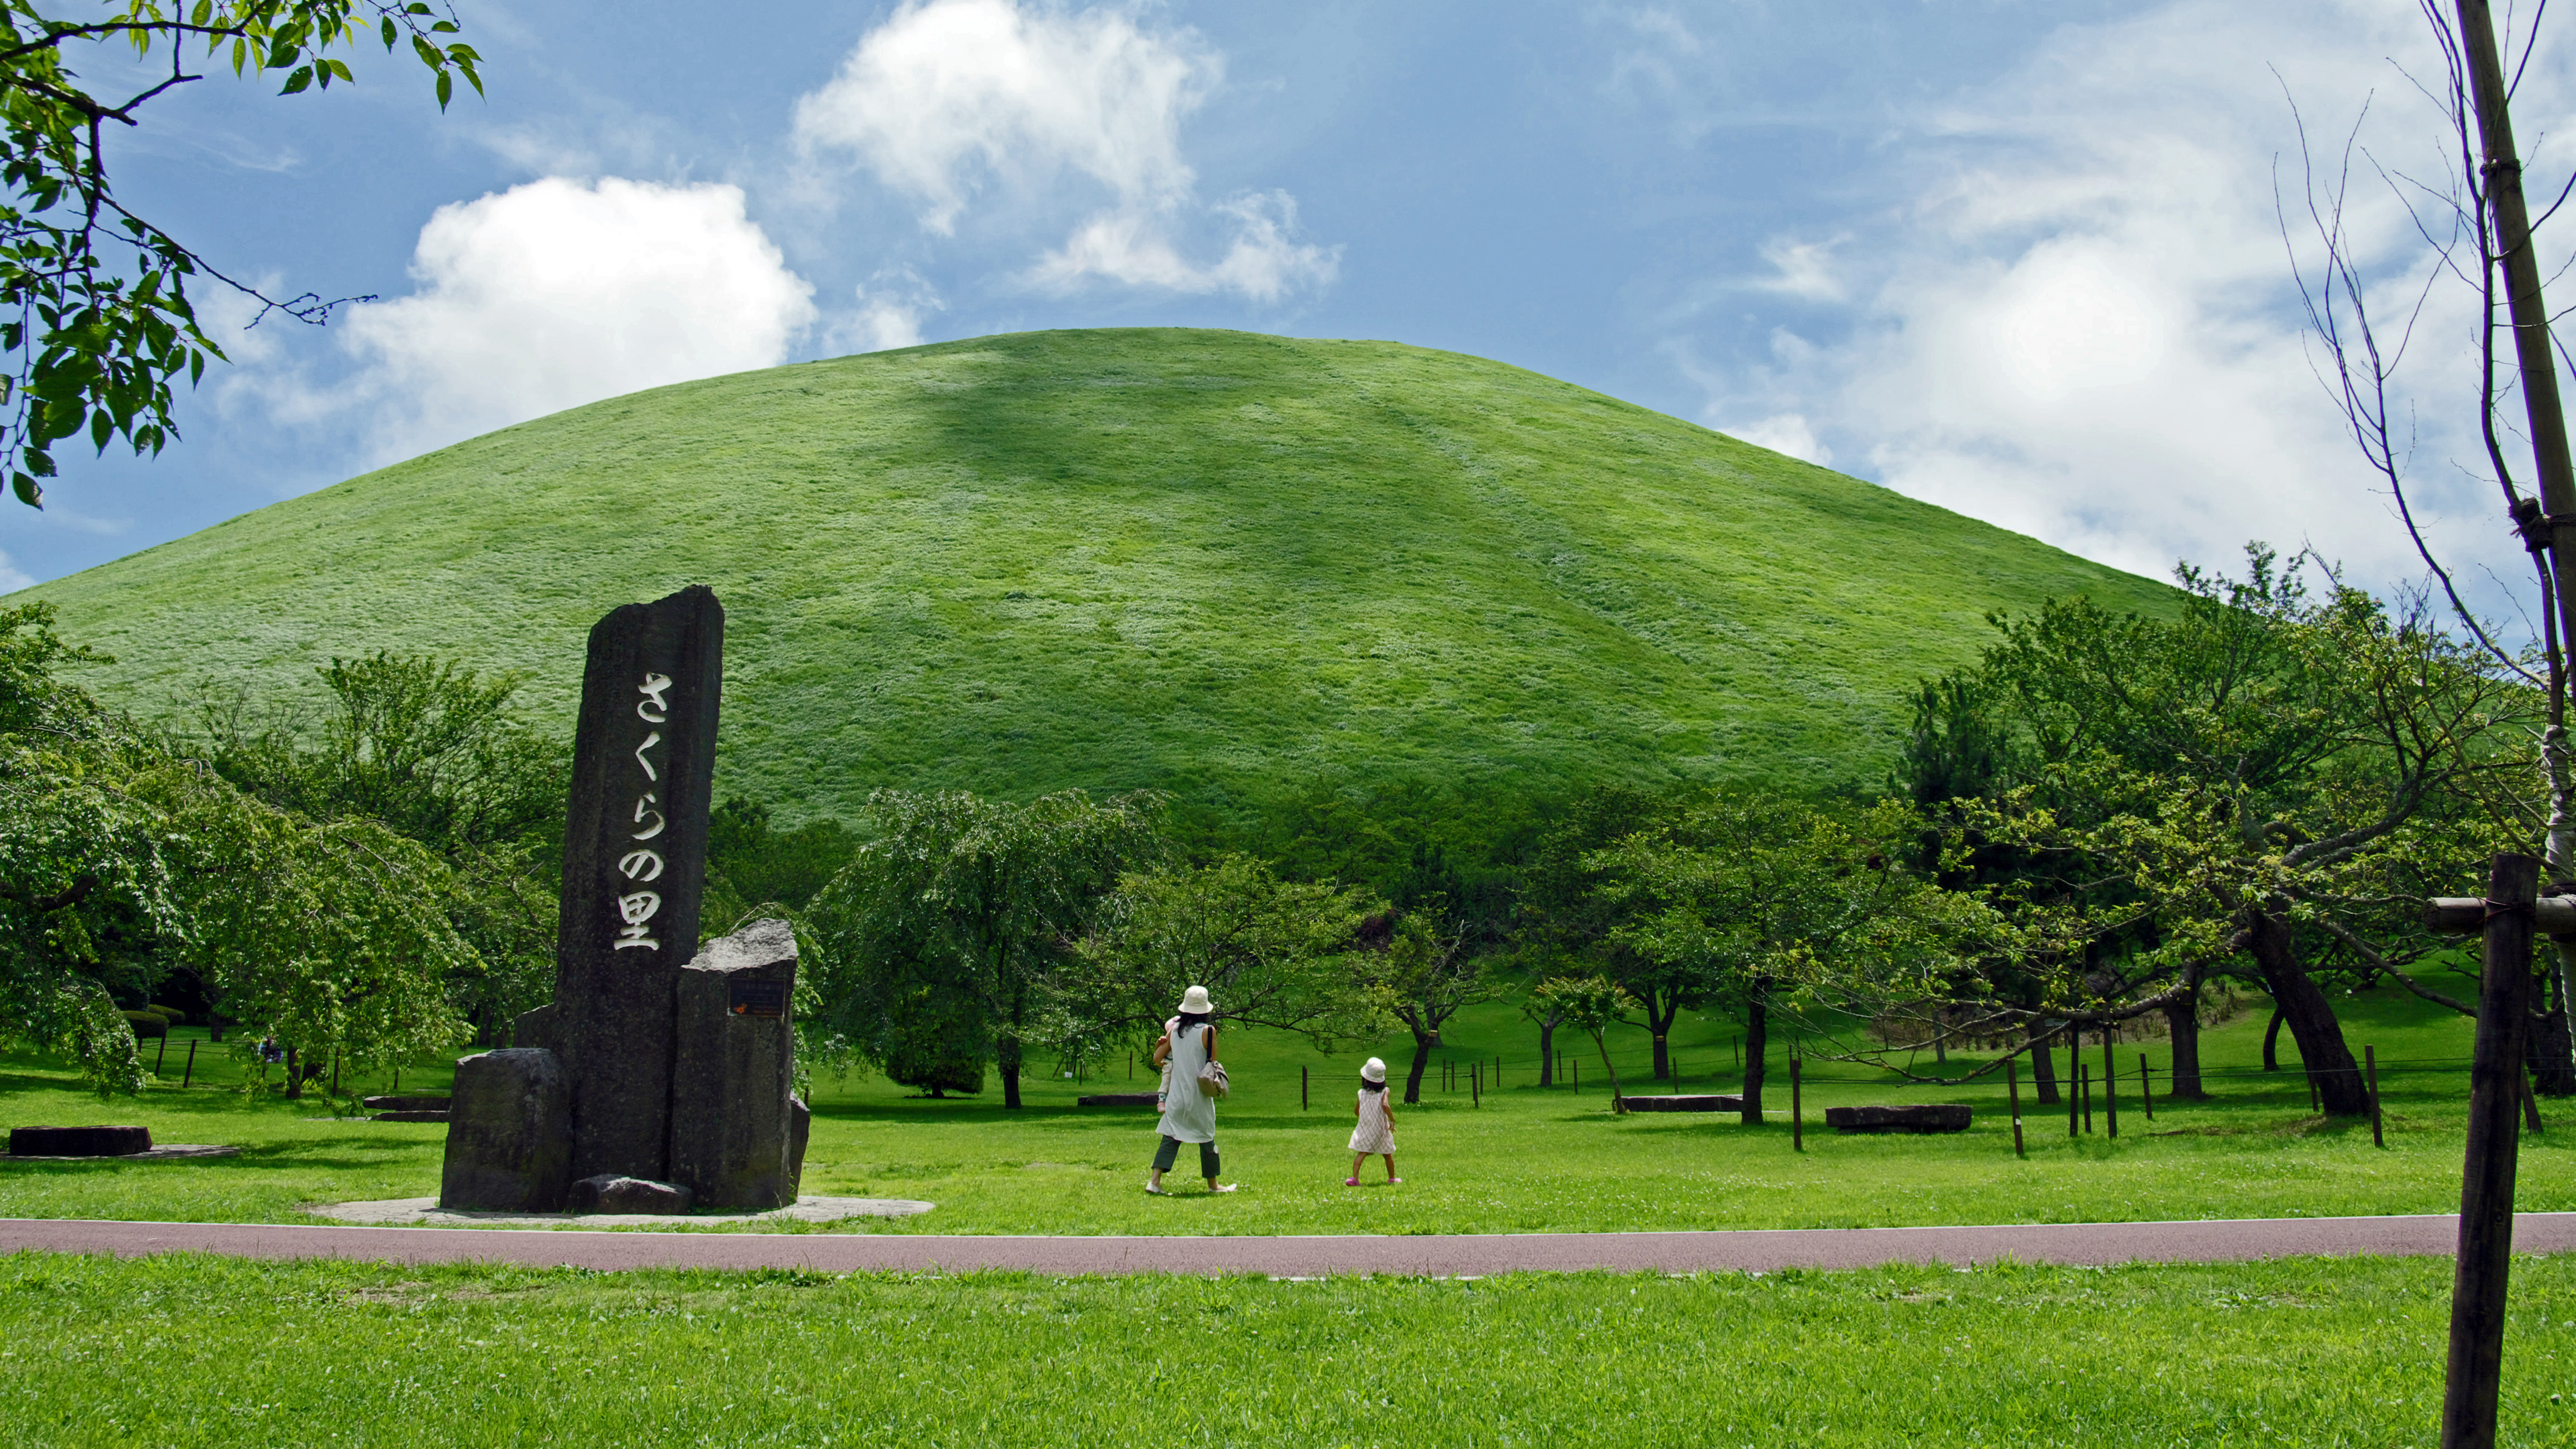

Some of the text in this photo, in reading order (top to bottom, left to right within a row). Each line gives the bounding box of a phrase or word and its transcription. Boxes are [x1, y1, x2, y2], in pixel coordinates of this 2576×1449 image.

[613, 672, 673, 951] さくらの里
